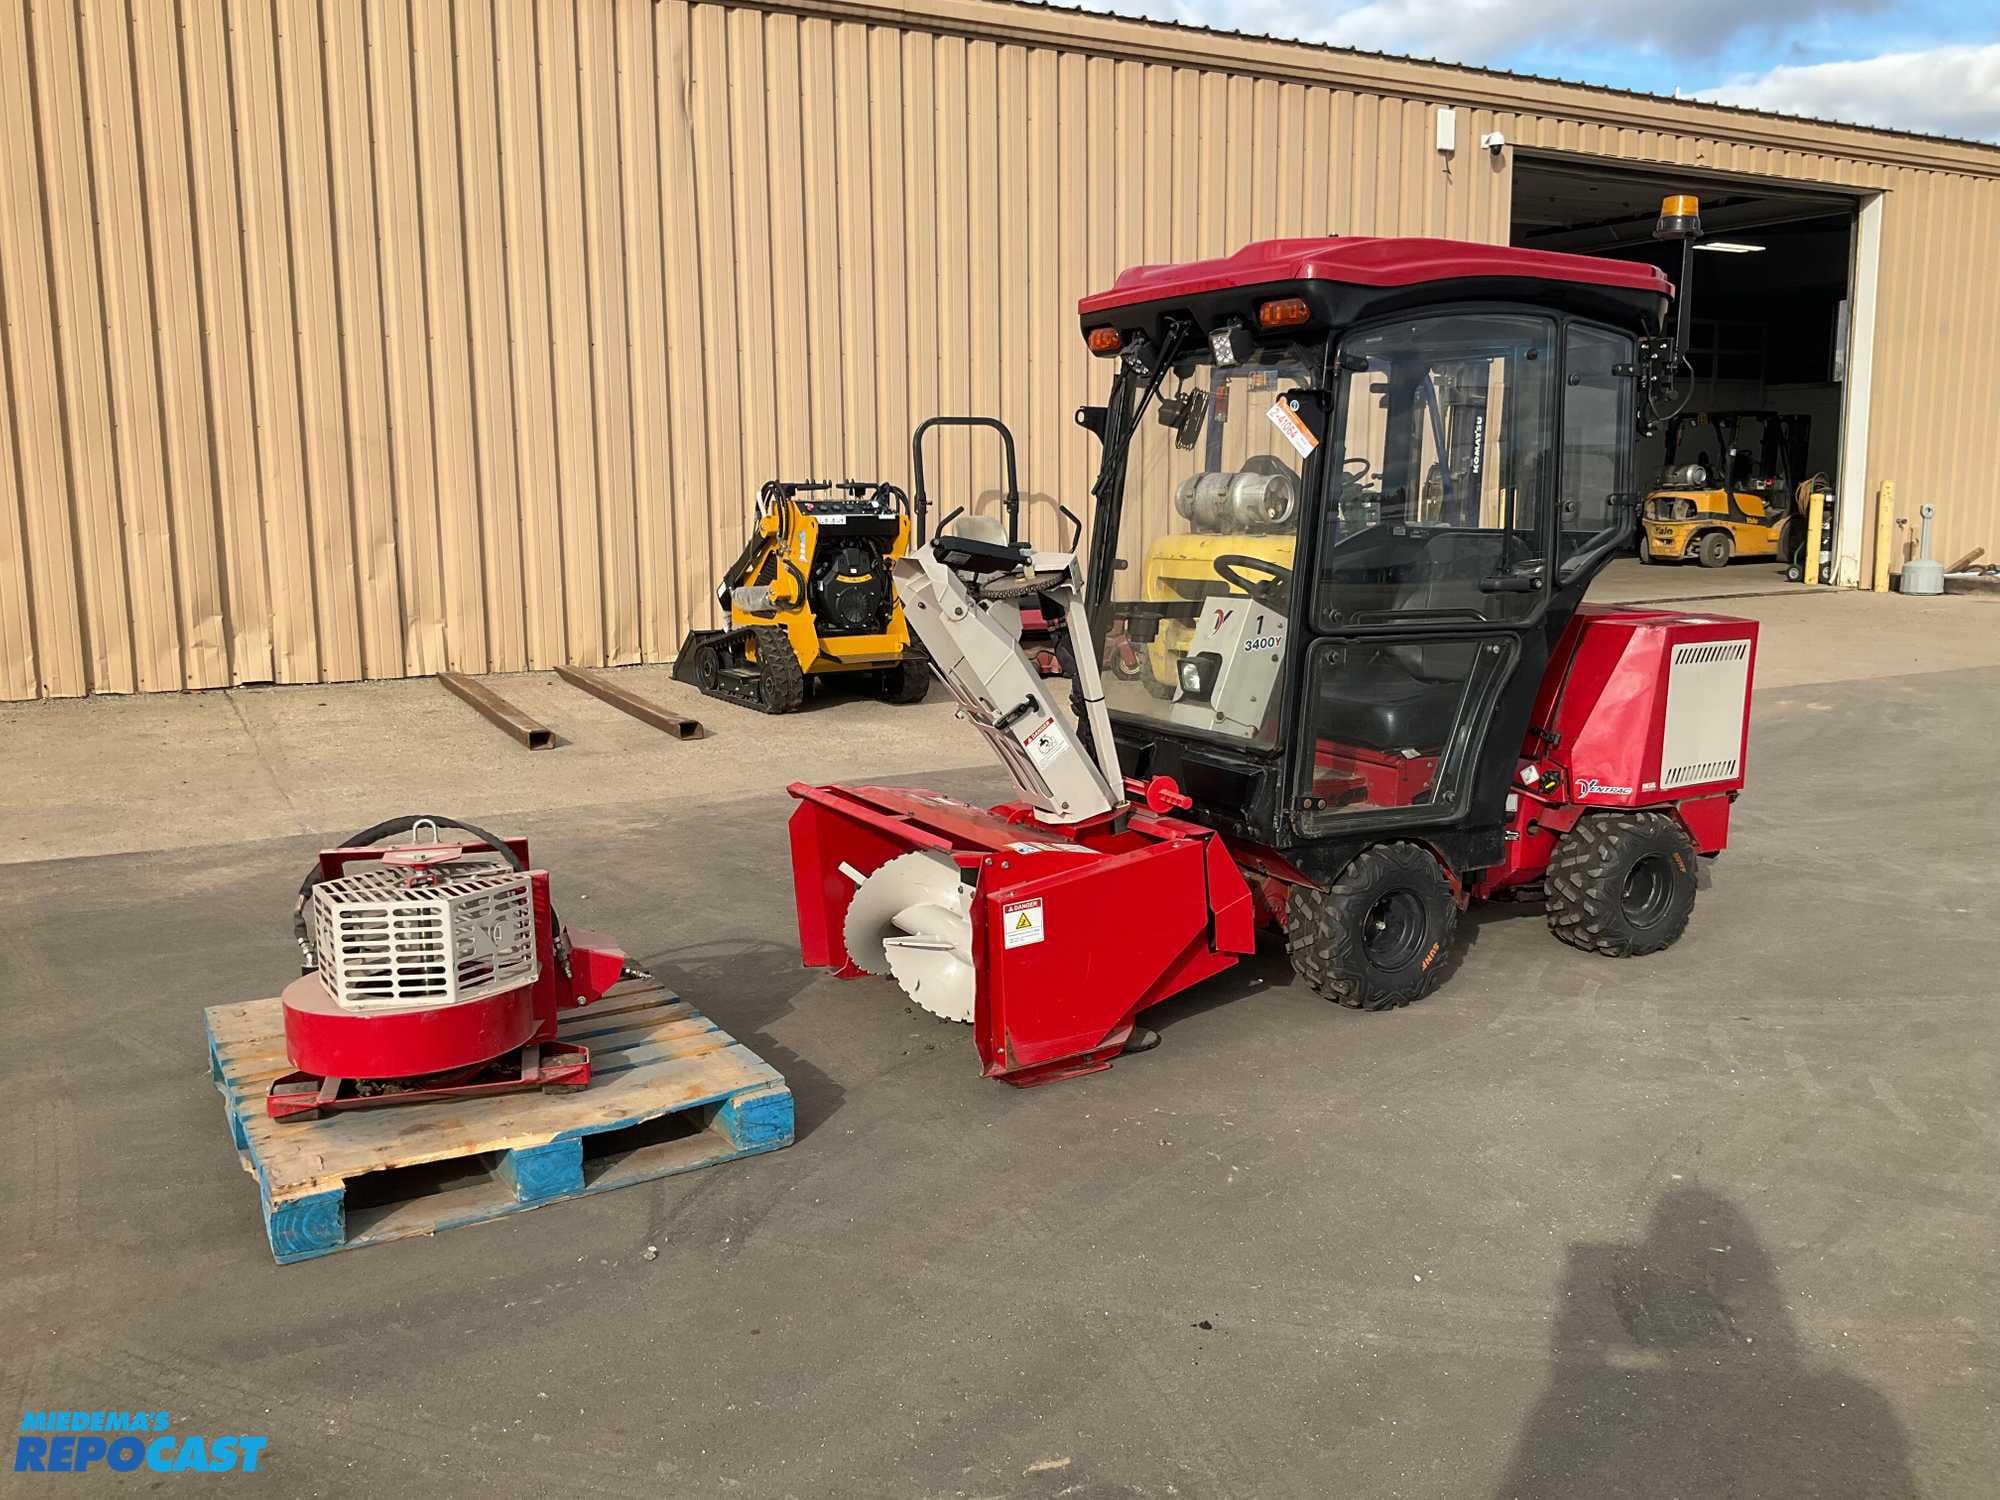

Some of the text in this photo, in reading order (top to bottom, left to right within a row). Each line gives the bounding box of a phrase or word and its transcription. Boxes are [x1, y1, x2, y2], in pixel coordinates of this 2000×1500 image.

[1472, 416, 1482, 474] KOMATSU
[1256, 615, 1264, 635] 1
[1244, 636, 1281, 652] 3400Y
[1013, 901, 1038, 911] DANGER
